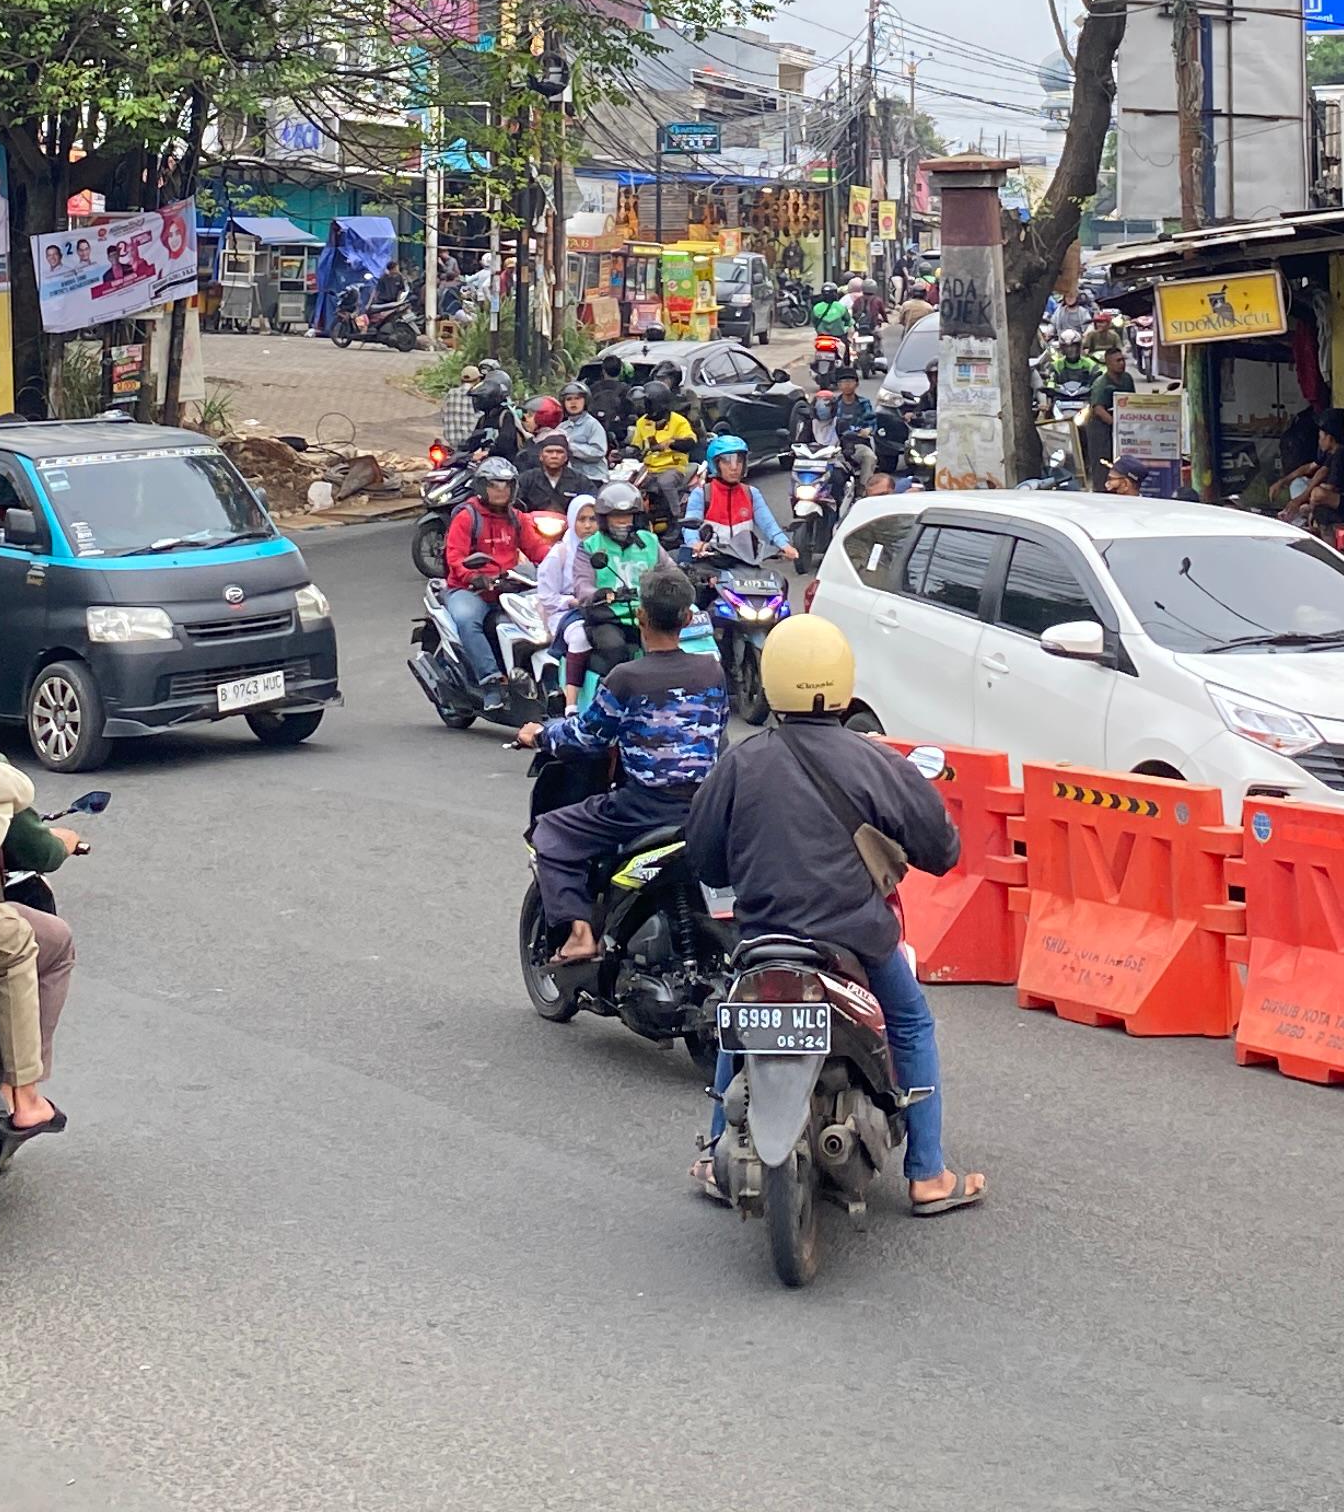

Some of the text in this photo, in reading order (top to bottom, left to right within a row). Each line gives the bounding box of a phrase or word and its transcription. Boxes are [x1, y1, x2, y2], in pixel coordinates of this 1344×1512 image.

[65, 242, 73, 255] 2
[943, 279, 977, 299] ADA
[940, 299, 992, 326] OJEK
[1155, 413, 1177, 422] CELL
[220, 687, 227, 701] B
[720, 1008, 826, 1029] B 6998 WLC
[1301, 1008, 1331, 1027] KOTA
